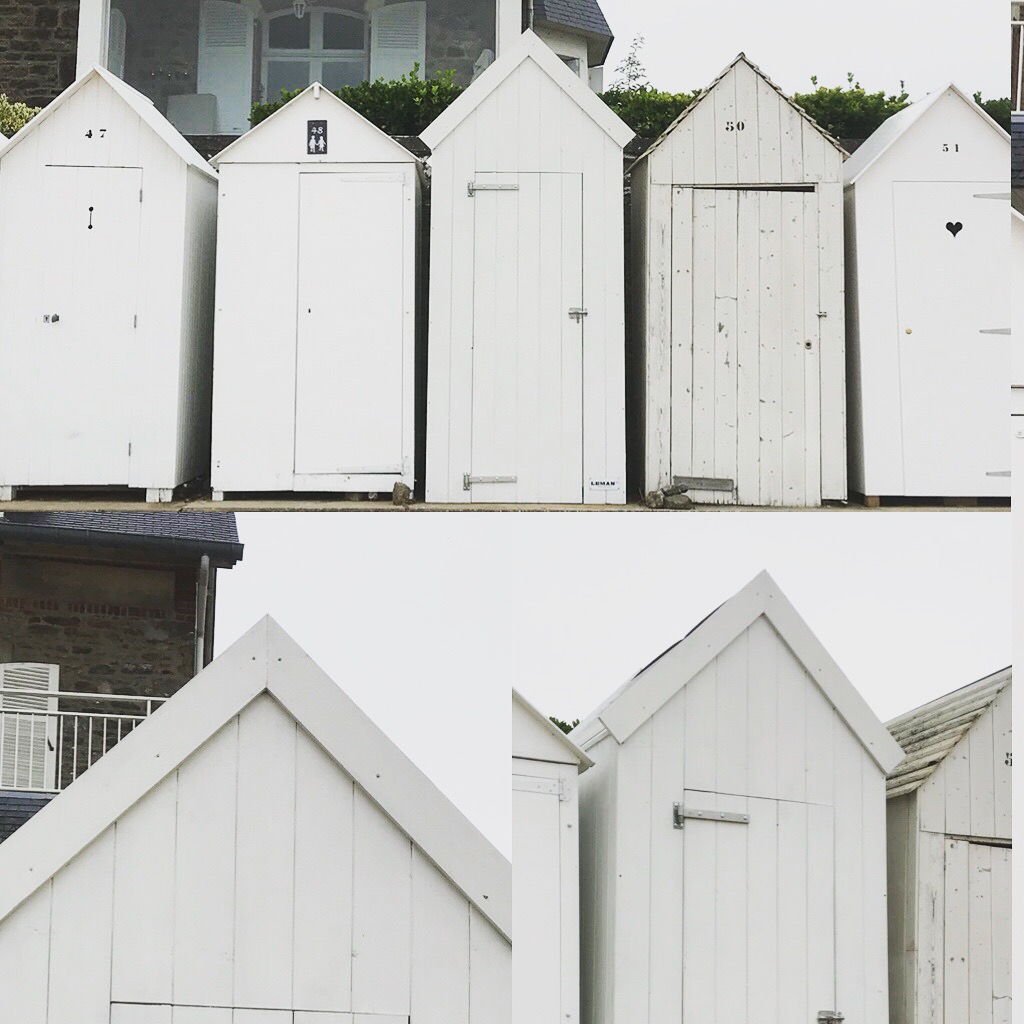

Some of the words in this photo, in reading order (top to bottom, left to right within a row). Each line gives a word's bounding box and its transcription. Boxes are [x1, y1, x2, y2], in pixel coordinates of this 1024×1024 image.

[311, 126, 324, 135] 48
[725, 121, 744, 131] 50
[85, 129, 107, 139] 47
[942, 143, 959, 153] 51
